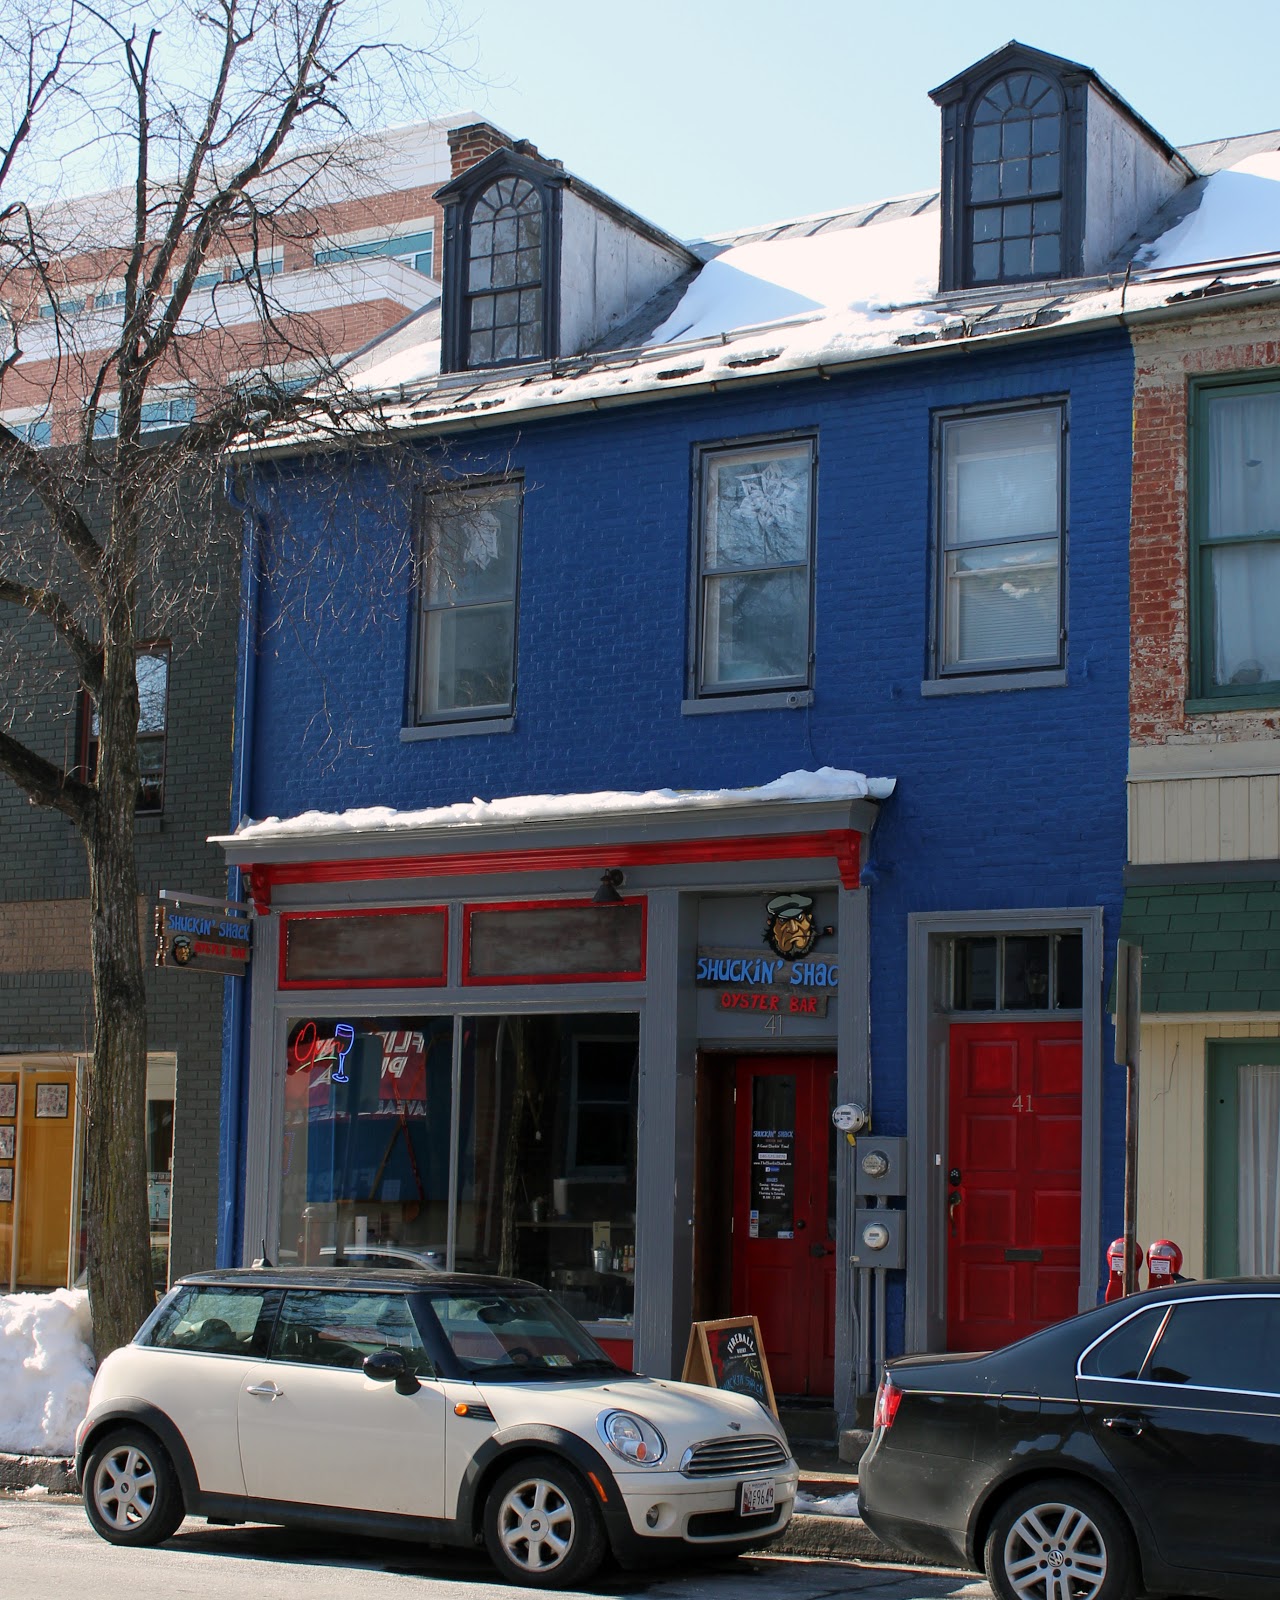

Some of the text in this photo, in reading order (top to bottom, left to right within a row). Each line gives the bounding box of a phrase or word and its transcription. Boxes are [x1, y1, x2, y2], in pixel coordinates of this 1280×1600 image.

[721, 991, 817, 1013] OYSTER BAR
[764, 1014, 783, 1036] 41
[1012, 1094, 1034, 1113] 41
[727, 1333, 754, 1353] FIREBALL
